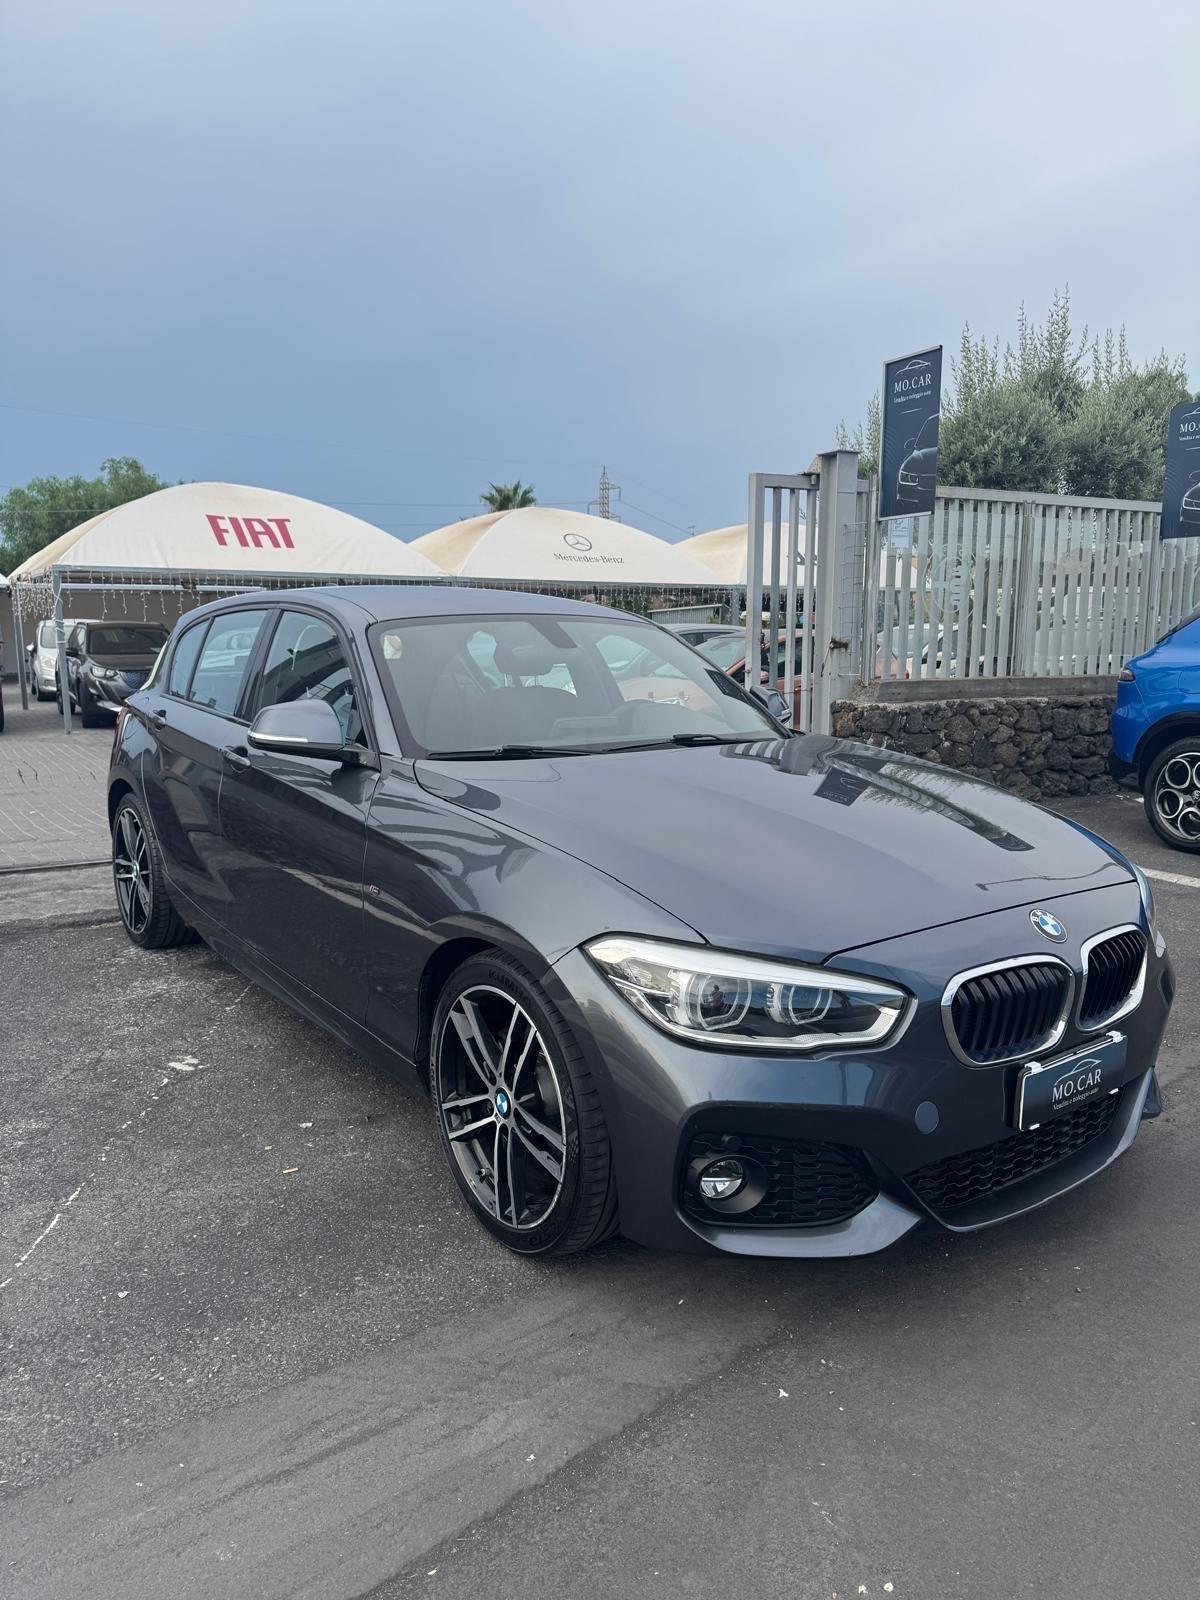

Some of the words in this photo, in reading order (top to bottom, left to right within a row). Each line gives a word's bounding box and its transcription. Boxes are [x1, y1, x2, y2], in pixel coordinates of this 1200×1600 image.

[894, 373, 931, 393] MO.CAR
[1179, 422, 1200, 433] MO.
[206, 514, 295, 548] FIAT
[553, 553, 624, 564] Mercedes-Benz
[1052, 1068, 1102, 1103] MO.CAR
